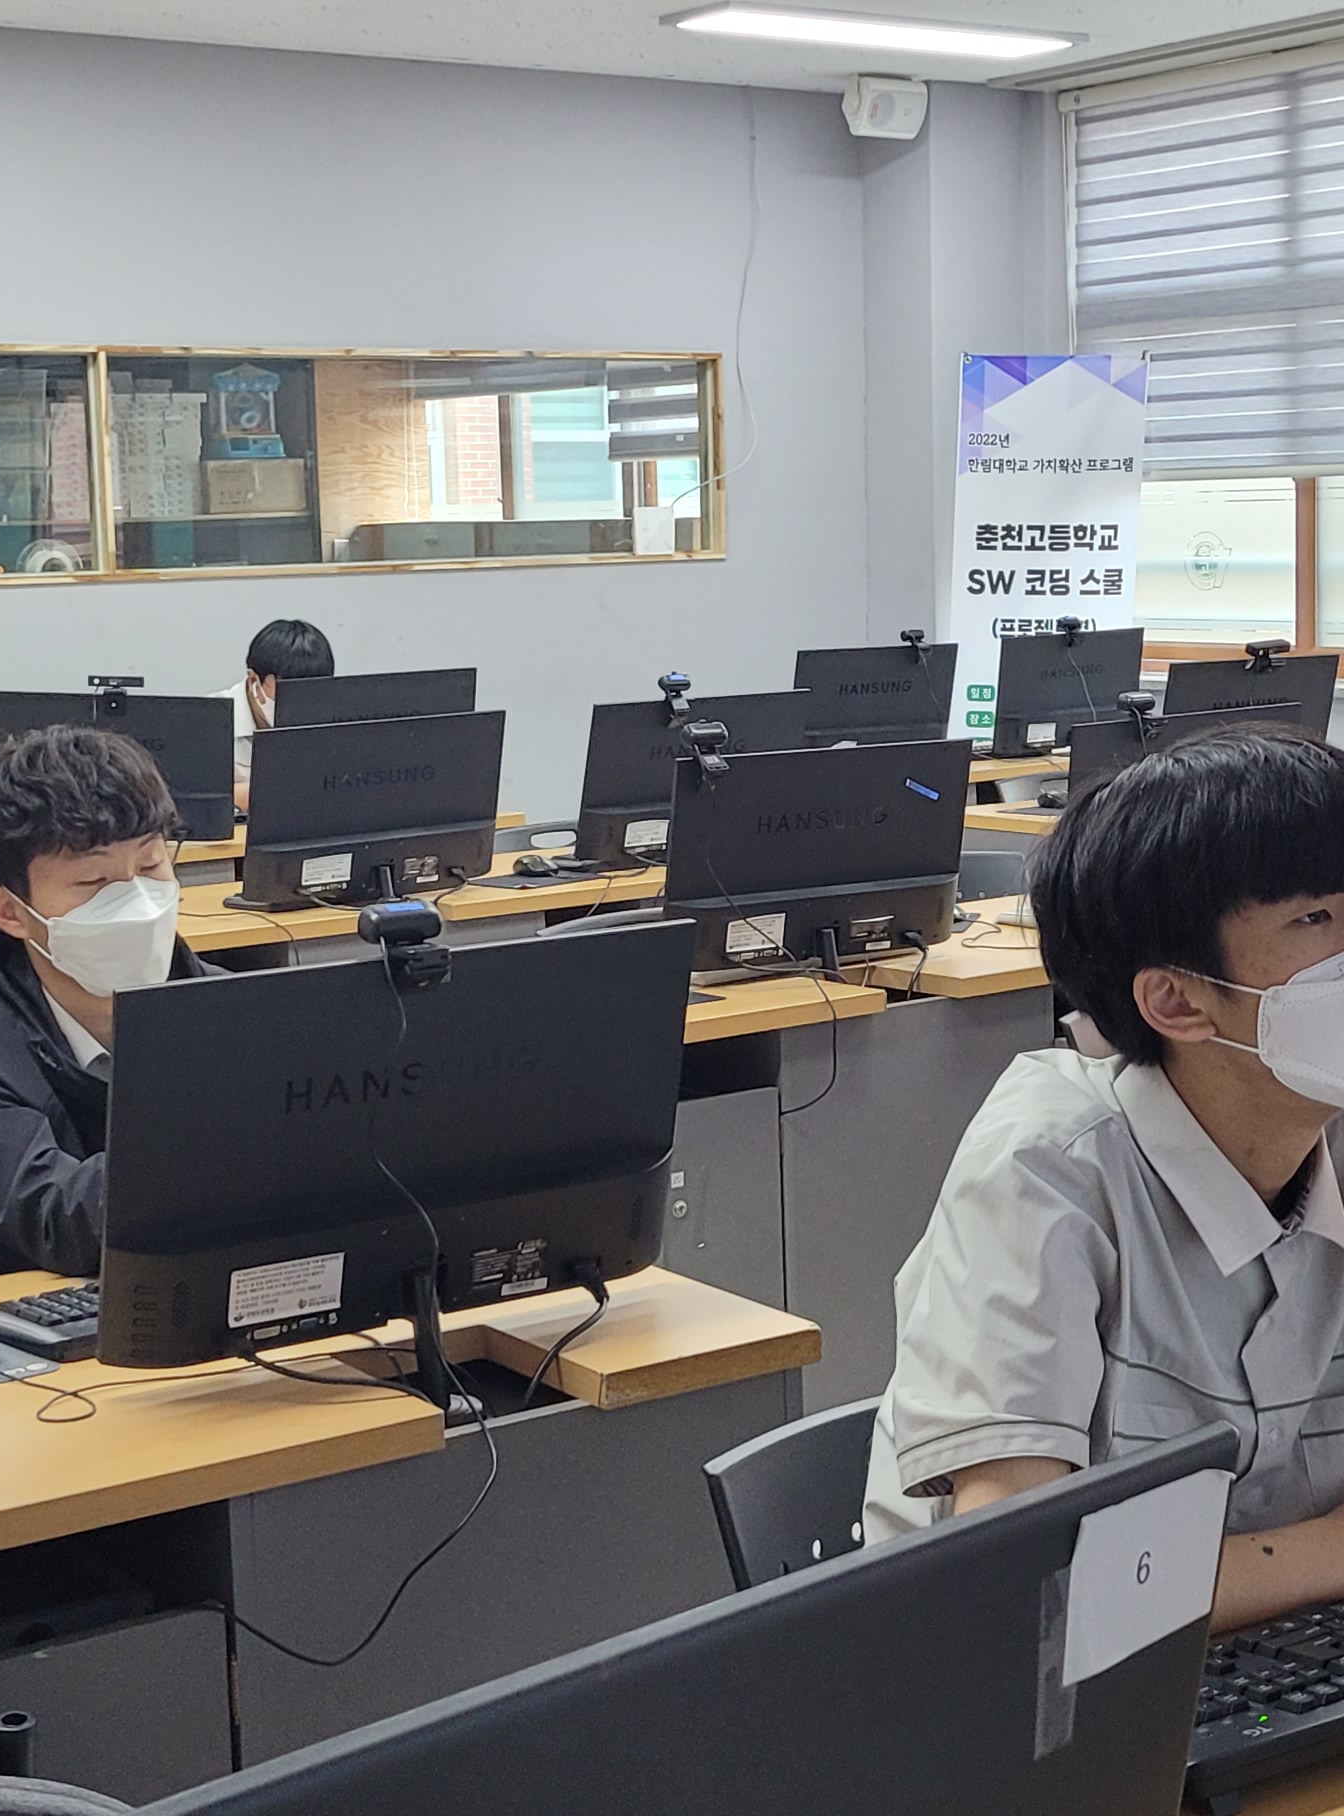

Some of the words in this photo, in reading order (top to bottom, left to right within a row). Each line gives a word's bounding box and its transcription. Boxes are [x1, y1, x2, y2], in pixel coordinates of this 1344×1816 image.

[968, 433, 1010, 448] 2022년
[967, 457, 1029, 474] 한림대학교
[1033, 457, 1083, 474] 가치확산
[1085, 456, 1134, 473] 프로그램
[975, 523, 1119, 552] 춘천고등학교
[966, 568, 1016, 596] SW
[1024, 568, 1071, 597] 코딩
[1079, 568, 1124, 596] 스쿨
[839, 680, 913, 696] HANSUNG
[323, 765, 436, 791] HANSUNG
[756, 806, 889, 834] HANSUNG
[1136, 1550, 1152, 1585] 6
